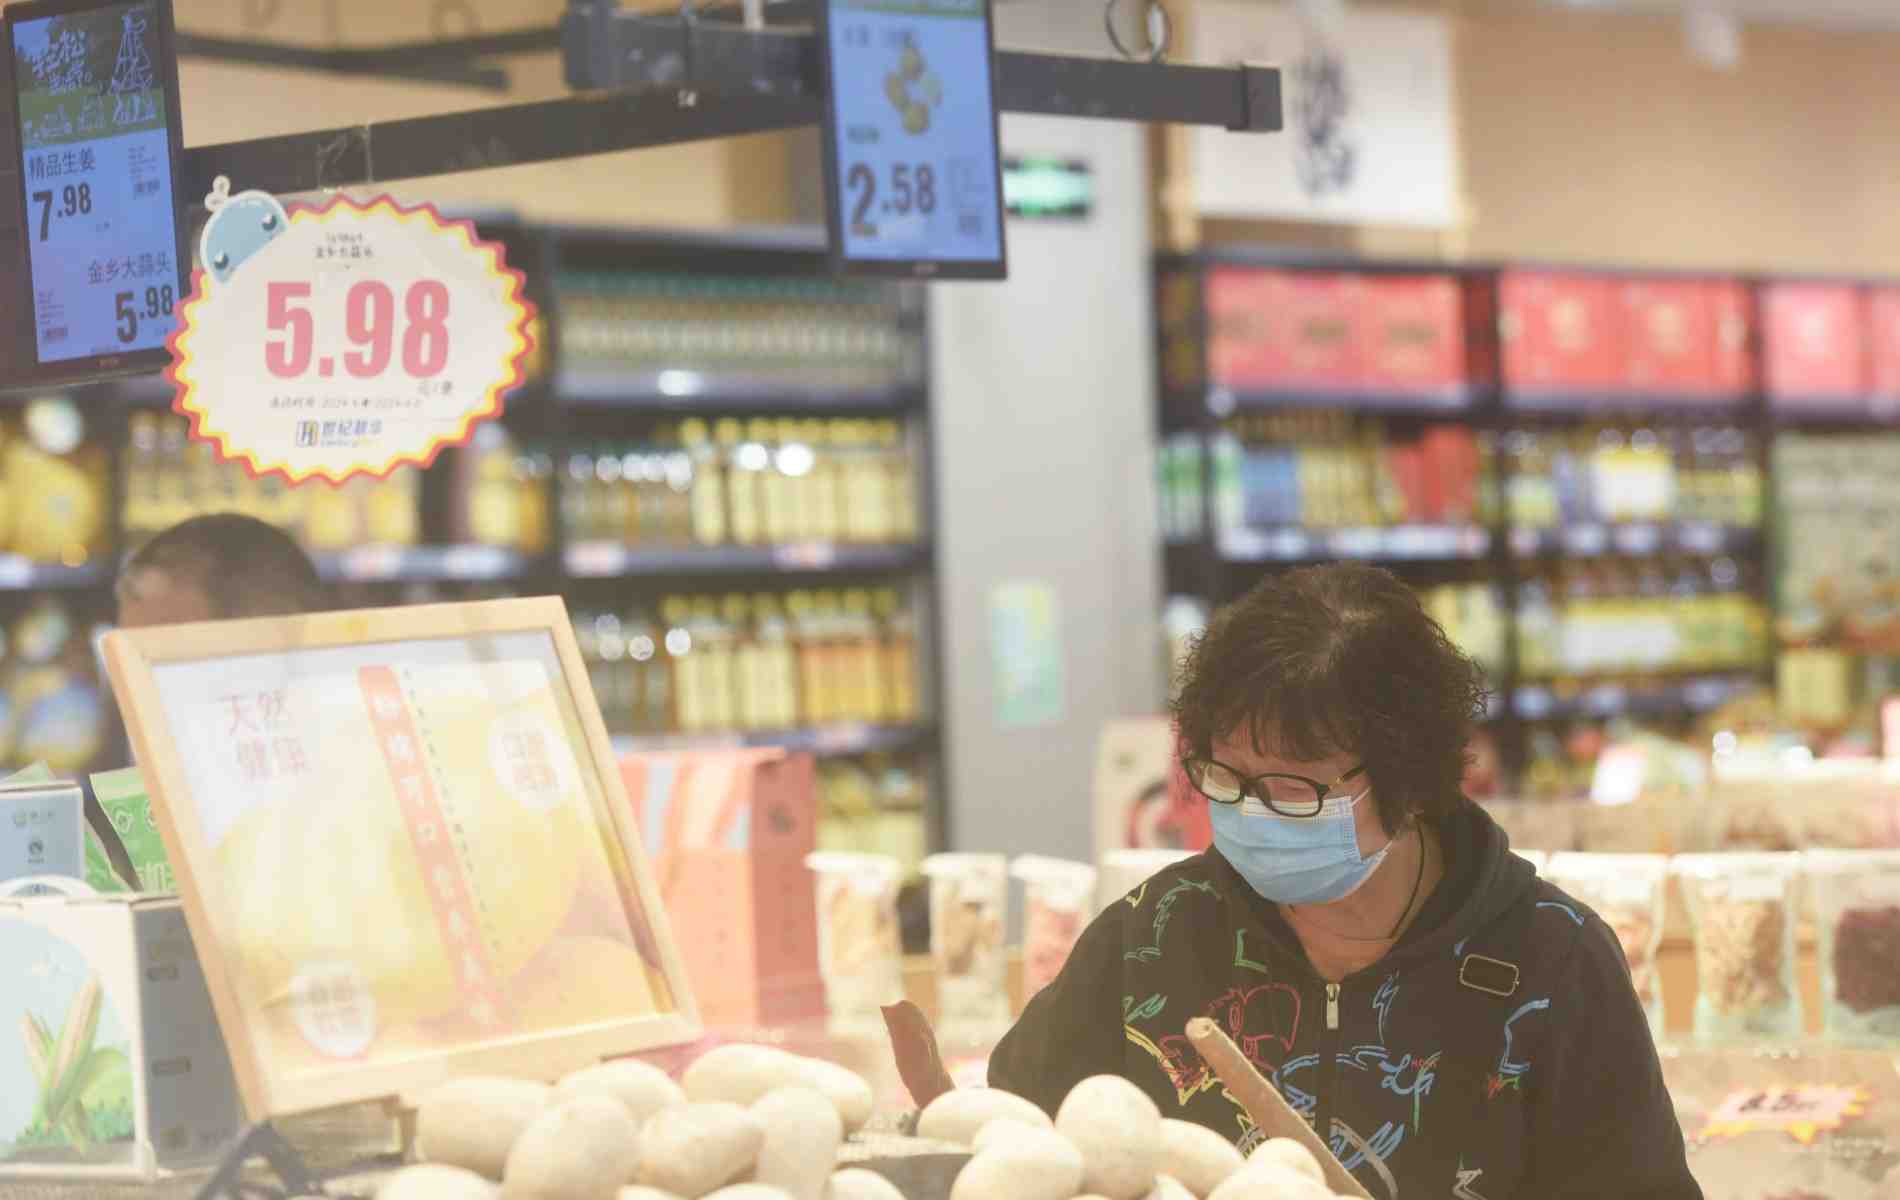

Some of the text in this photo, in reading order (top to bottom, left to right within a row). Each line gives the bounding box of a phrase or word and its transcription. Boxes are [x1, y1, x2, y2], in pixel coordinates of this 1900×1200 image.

[29, 149, 96, 181] 精品生姜
[32, 183, 92, 242] 7.98
[849, 162, 936, 236] 2.58
[88, 253, 172, 285] 金乡大蒜头
[115, 285, 173, 343] 5.98
[265, 279, 450, 379] 5.98
[217, 691, 289, 737] 天然
